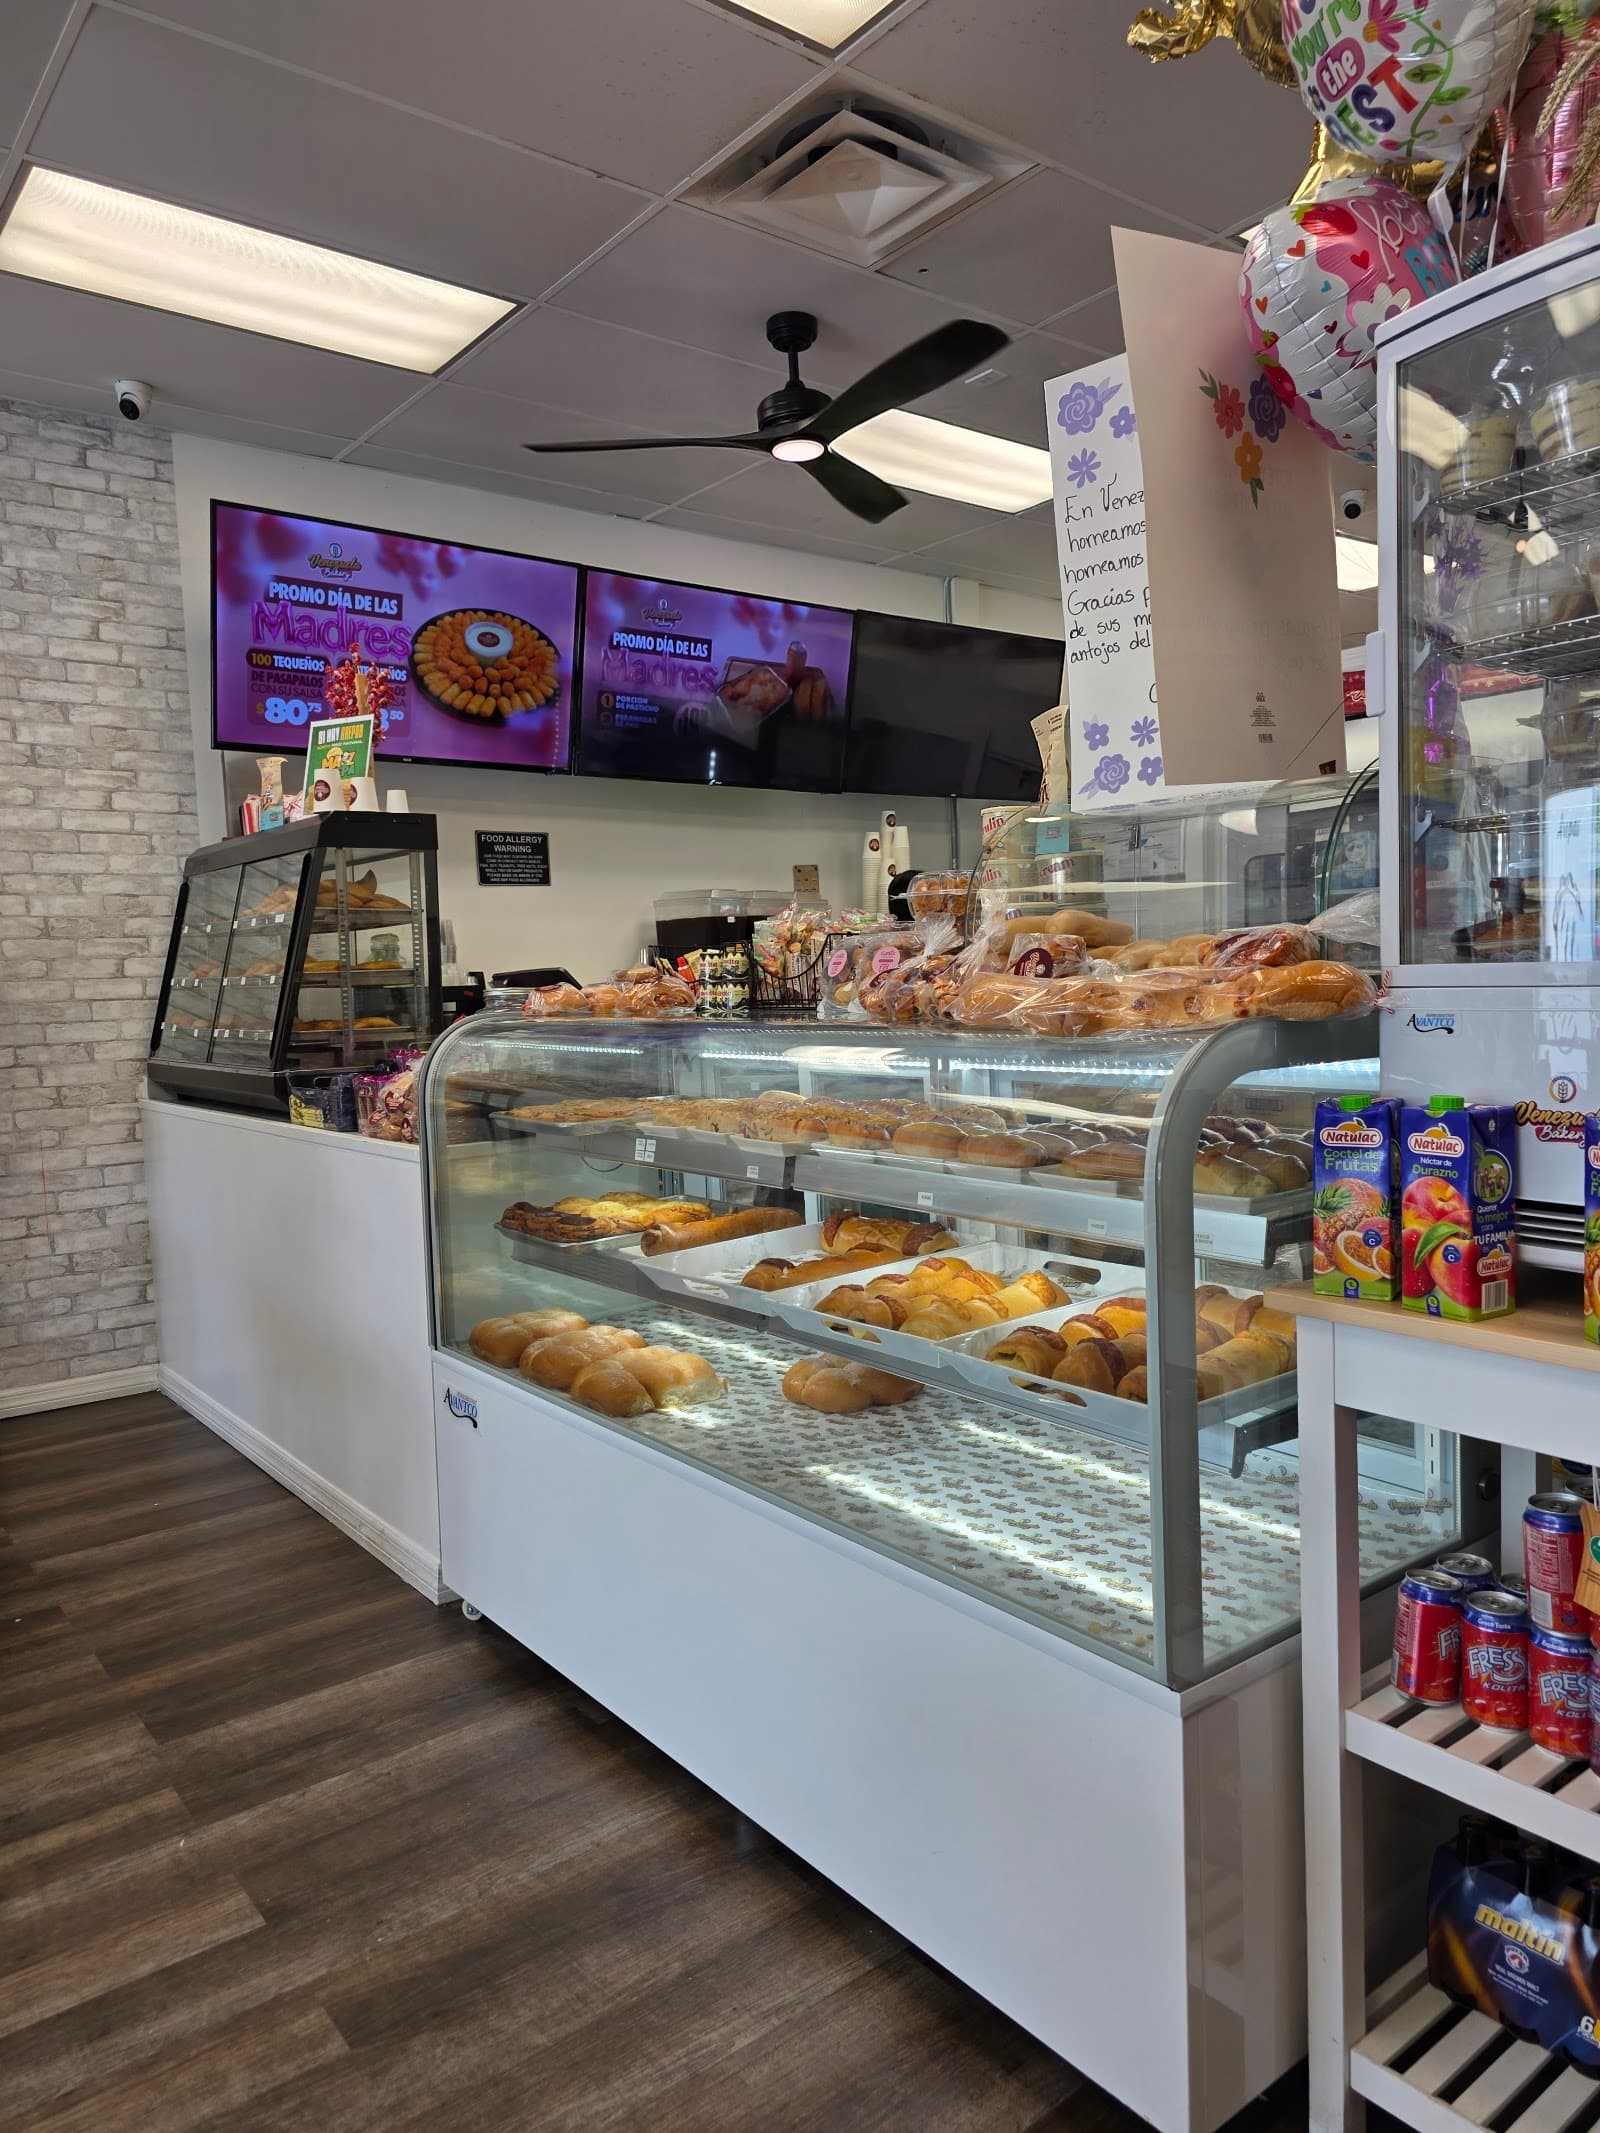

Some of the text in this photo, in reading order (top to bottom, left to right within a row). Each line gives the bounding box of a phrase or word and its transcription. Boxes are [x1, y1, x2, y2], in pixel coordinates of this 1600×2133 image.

[1321, 50, 1357, 96] the
[1064, 494, 1094, 524] En
[269, 582, 325, 605] PROMO
[354, 594, 373, 611] DE
[374, 596, 398, 616] LAS
[1067, 588, 1135, 616] Gracias
[251, 601, 412, 658] Madres
[1069, 620, 1087, 639] de
[1097, 618, 1120, 634] sus
[613, 632, 654, 649] PROMO
[675, 641, 689, 656] DE
[690, 643, 708, 658] LAS
[1070, 629, 1151, 665] antojos del
[251, 653, 325, 672] 100 TEQUEÑOS
[601, 648, 718, 694] Madres
[251, 670, 265, 682] DE
[481, 834, 543, 844] FOOD ALLERGY
[493, 844, 533, 853] WARNING
[1405, 1013, 1455, 1035] AVANTCO
[1325, 1131, 1377, 1143] Natulac
[1413, 1137, 1460, 1153] Natulac
[1324, 1157, 1379, 1173] Frutas
[1412, 1164, 1458, 1179] Durazno
[443, 1387, 478, 1429] AVANTCO
